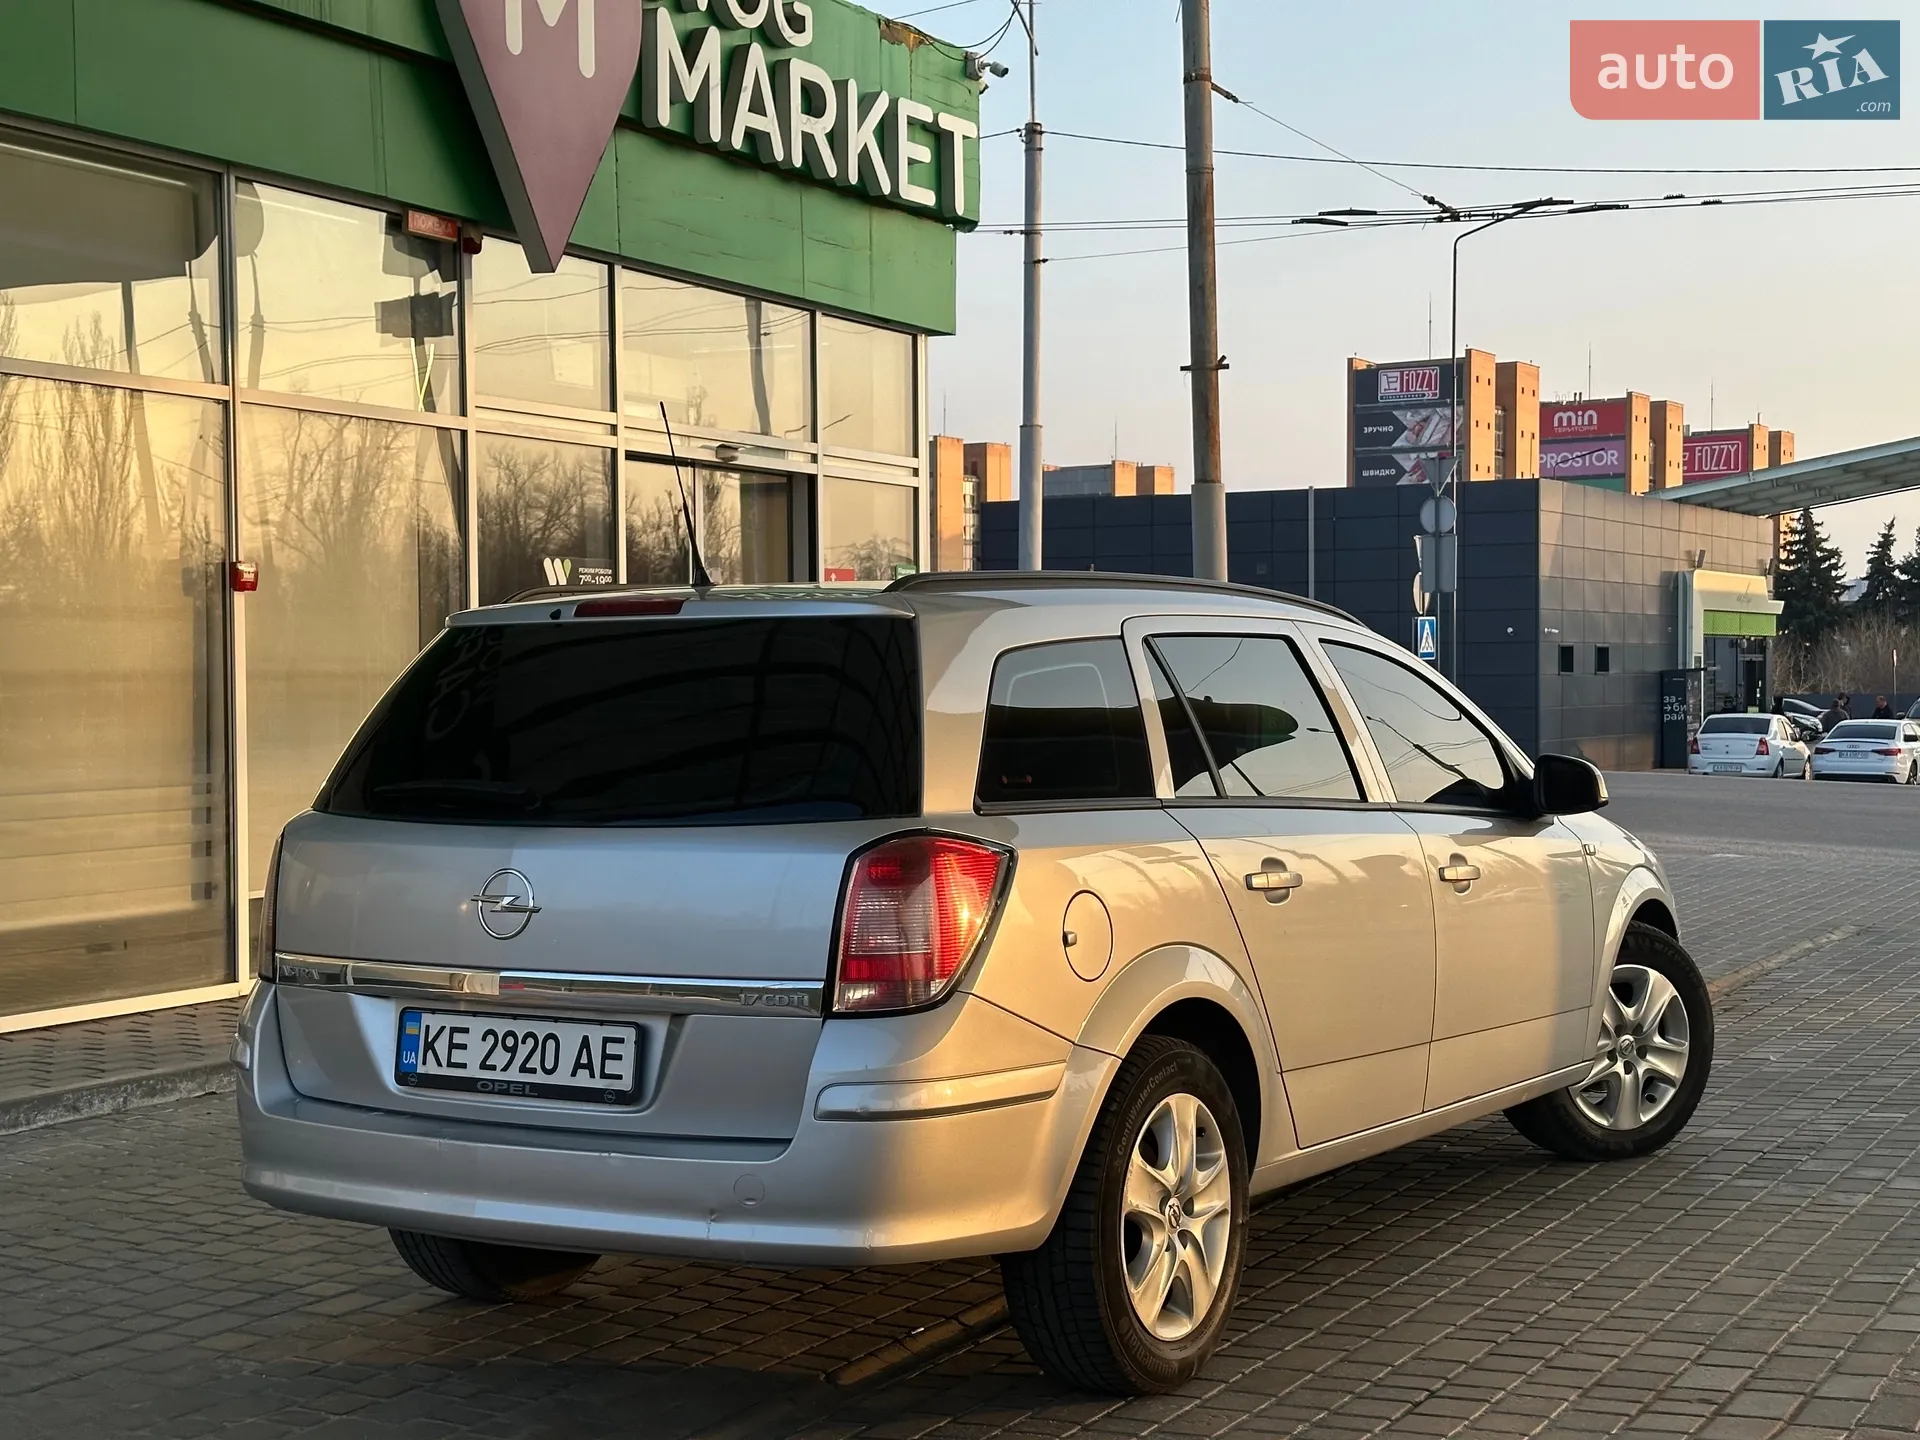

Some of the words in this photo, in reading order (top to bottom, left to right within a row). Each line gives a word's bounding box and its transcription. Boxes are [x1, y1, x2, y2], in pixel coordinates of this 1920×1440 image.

[656, 7, 977, 216] MARKET
[1403, 369, 1437, 392] FOZZY
[1553, 410, 1598, 427] min
[1363, 425, 1394, 433] ЗРУЧНО
[1540, 450, 1618, 468] PROSTOR
[1694, 444, 1738, 471] FOZZY
[1362, 468, 1396, 476] ШВИДКО
[403, 1051, 416, 1064] UA
[422, 1024, 469, 1069] KE
[479, 1028, 560, 1075] 2920
[570, 1034, 625, 1080] AE
[476, 1080, 538, 1096] OPEL
